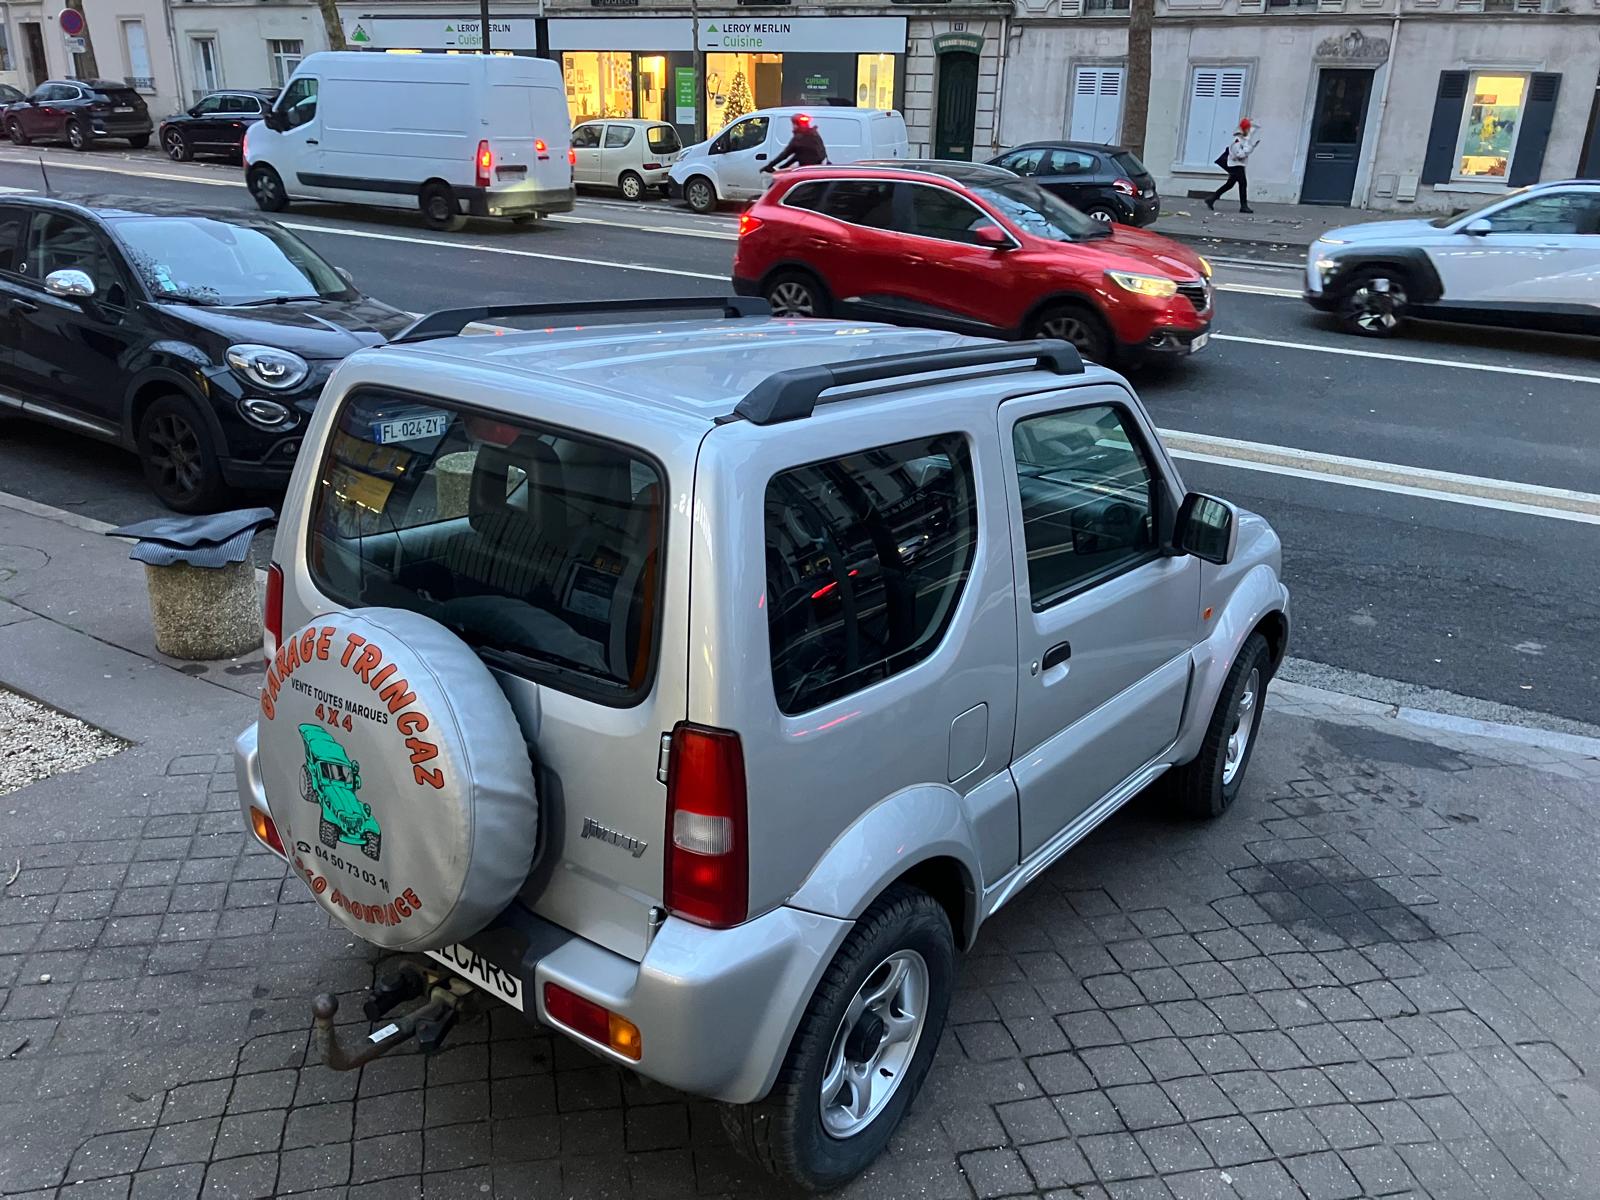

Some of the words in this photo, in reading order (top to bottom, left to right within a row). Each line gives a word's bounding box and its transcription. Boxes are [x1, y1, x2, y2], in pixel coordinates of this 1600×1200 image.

[457, 24, 479, 32] LEROY
[488, 24, 511, 32] ERLIN
[723, 24, 751, 33] LEROY
[754, 24, 791, 33] MERLIN
[723, 35, 763, 47] Cuisine
[261, 627, 336, 720] GARAGE
[341, 633, 444, 789] TRINCAZ
[291, 678, 312, 696] VENTE
[313, 687, 343, 709] TOUTES
[344, 700, 388, 724] MARQUES
[315, 846, 328, 861] 04
[331, 854, 343, 870] 50
[346, 862, 359, 878] 73
[362, 870, 376, 886] 03
